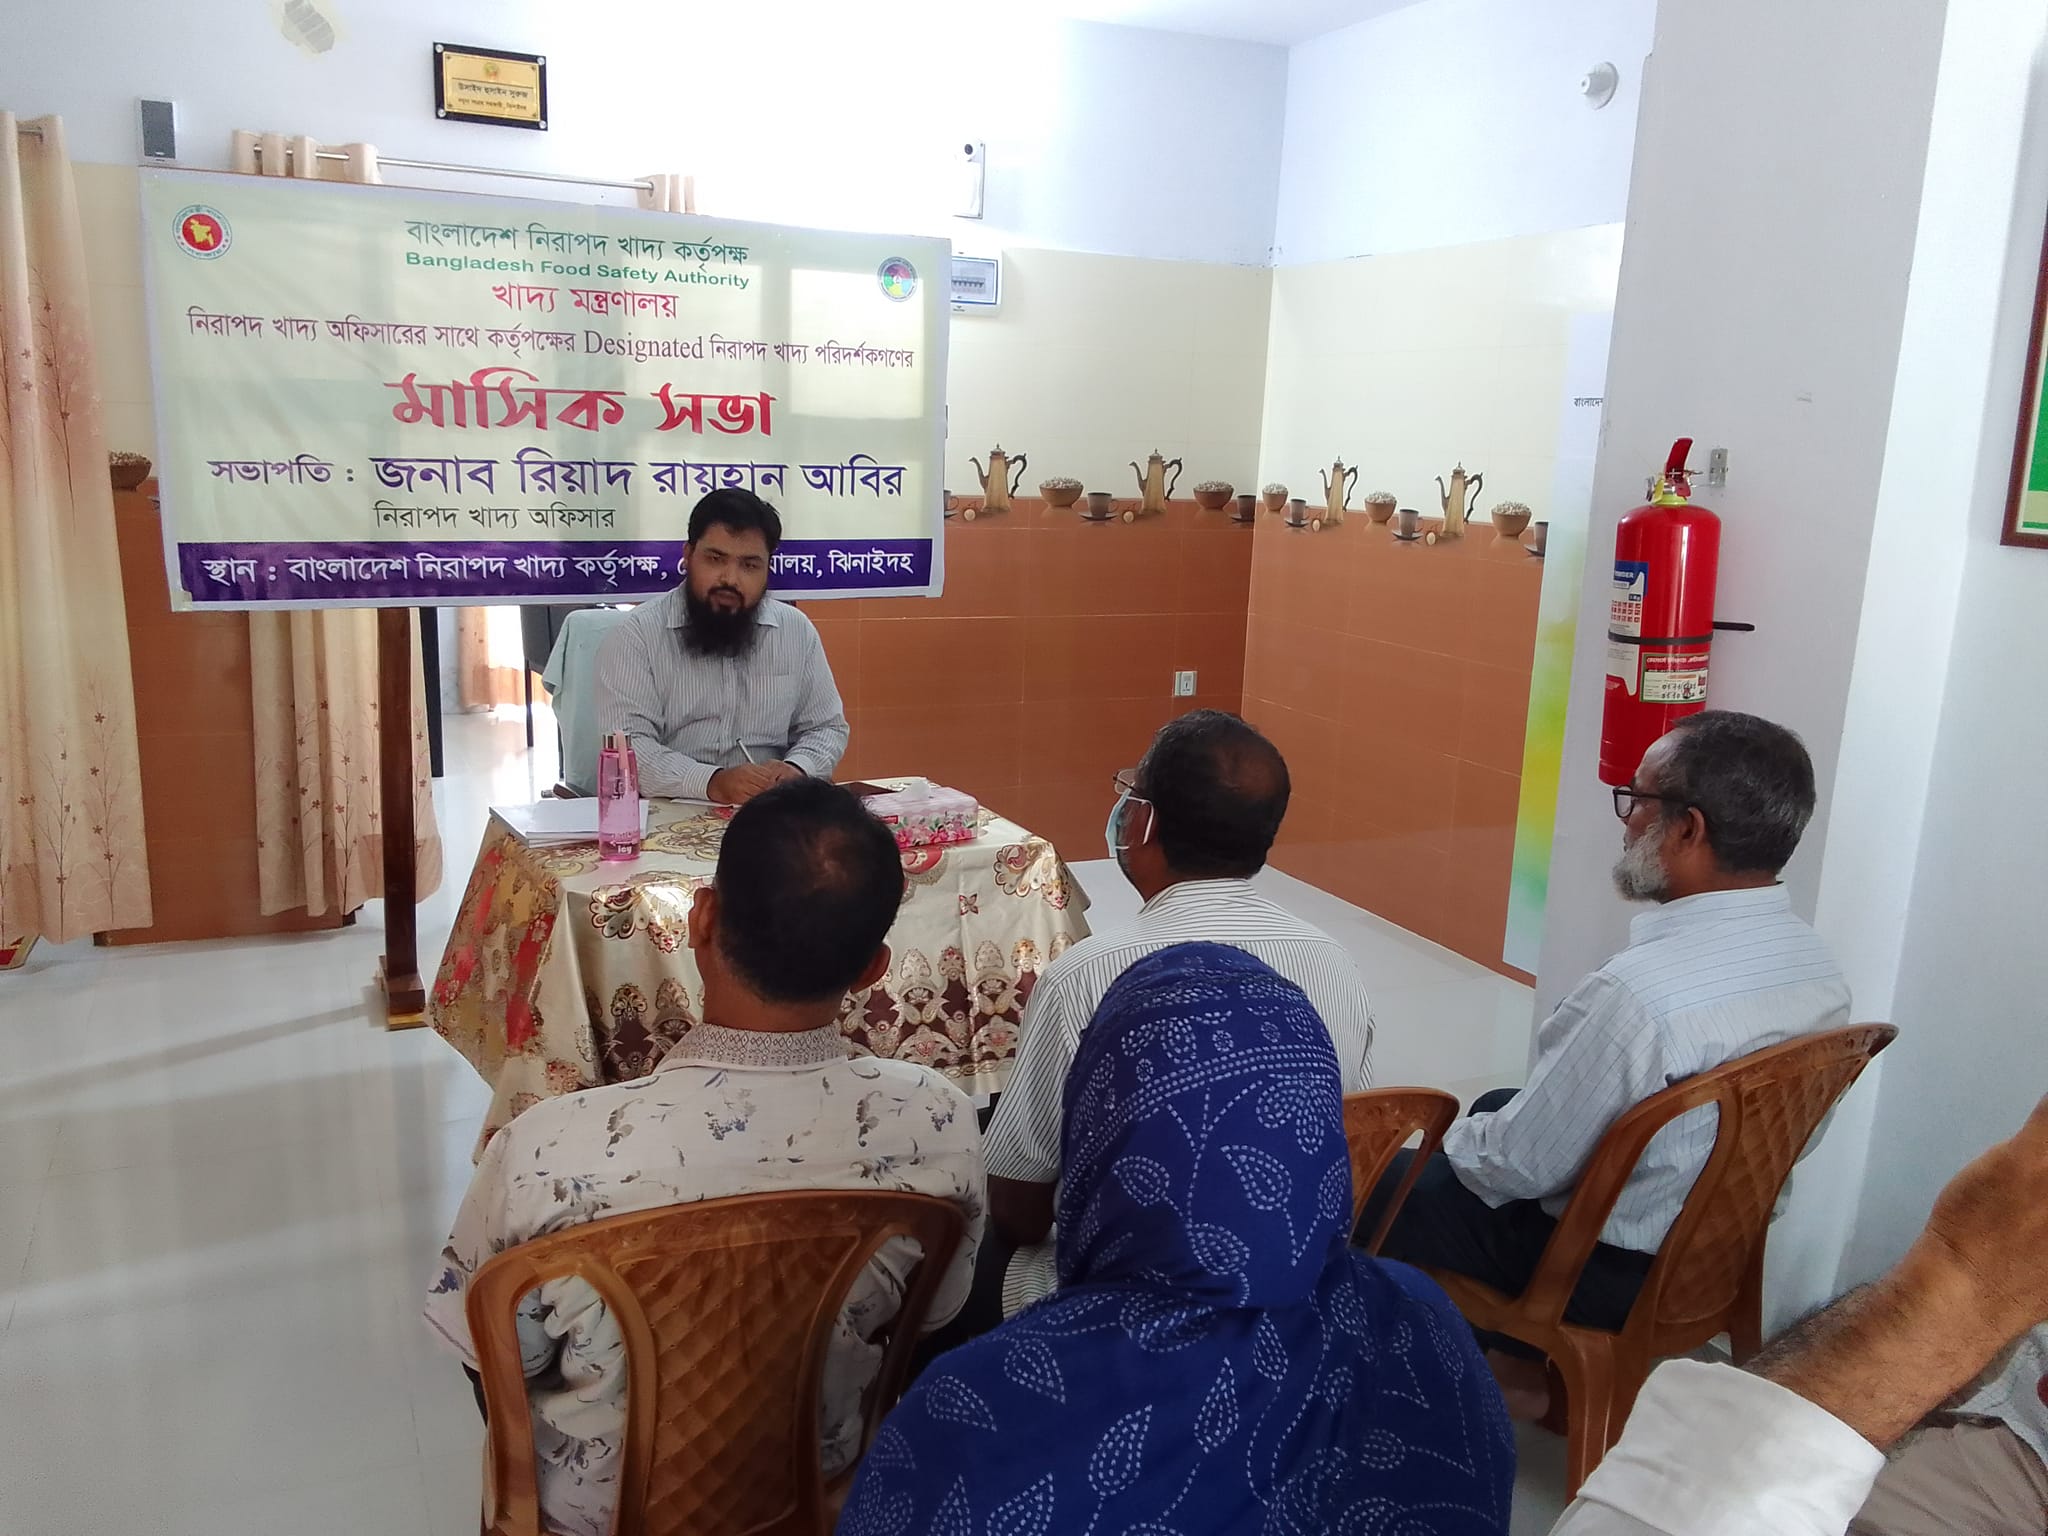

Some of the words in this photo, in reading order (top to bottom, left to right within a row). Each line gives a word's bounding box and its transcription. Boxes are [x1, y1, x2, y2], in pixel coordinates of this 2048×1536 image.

[405, 220, 519, 250] বাংলাদেশ
[527, 222, 610, 254] নিরাপদ
[617, 234, 664, 259] খাদ্য
[673, 237, 749, 273] কর্তৃপক্ষ
[406, 251, 534, 273] Bangladesh
[541, 260, 591, 277] Food
[597, 264, 658, 283] Safety
[663, 269, 750, 290] Authority
[492, 280, 558, 313] খাদ্য
[570, 286, 679, 319] মন্ত্রণালয়
[187, 305, 264, 338] নিরাপদ
[273, 315, 317, 342] খাদ্য
[326, 314, 427, 346] অফিসারের
[434, 325, 479, 348] সাথে
[486, 323, 576, 359] কর্তৃপক্ষের
[584, 330, 704, 363] Designated
[709, 333, 768, 362] নিরাপদ
[773, 340, 807, 364] খাদ্য
[814, 339, 914, 368] পরিদর্শকগণের
[384, 366, 627, 432] মাসিক
[650, 381, 777, 437] সভা
[206, 453, 333, 485] সভাপতি
[368, 454, 499, 495] জনাব
[511, 446, 638, 496] রিয়াদ
[647, 459, 788, 497] রায়হান
[799, 453, 907, 498] আবির
[372, 500, 459, 529] নিরাপদ
[468, 505, 520, 529] খাদ্য
[528, 501, 616, 529] অফিসার
[201, 557, 257, 587] স্থান
[284, 554, 409, 583] বাংলাদেশ
[415, 552, 506, 581] নিরাপদ
[512, 552, 566, 578] খাদ্য
[828, 546, 914, 574] ঝিনাইদহ
